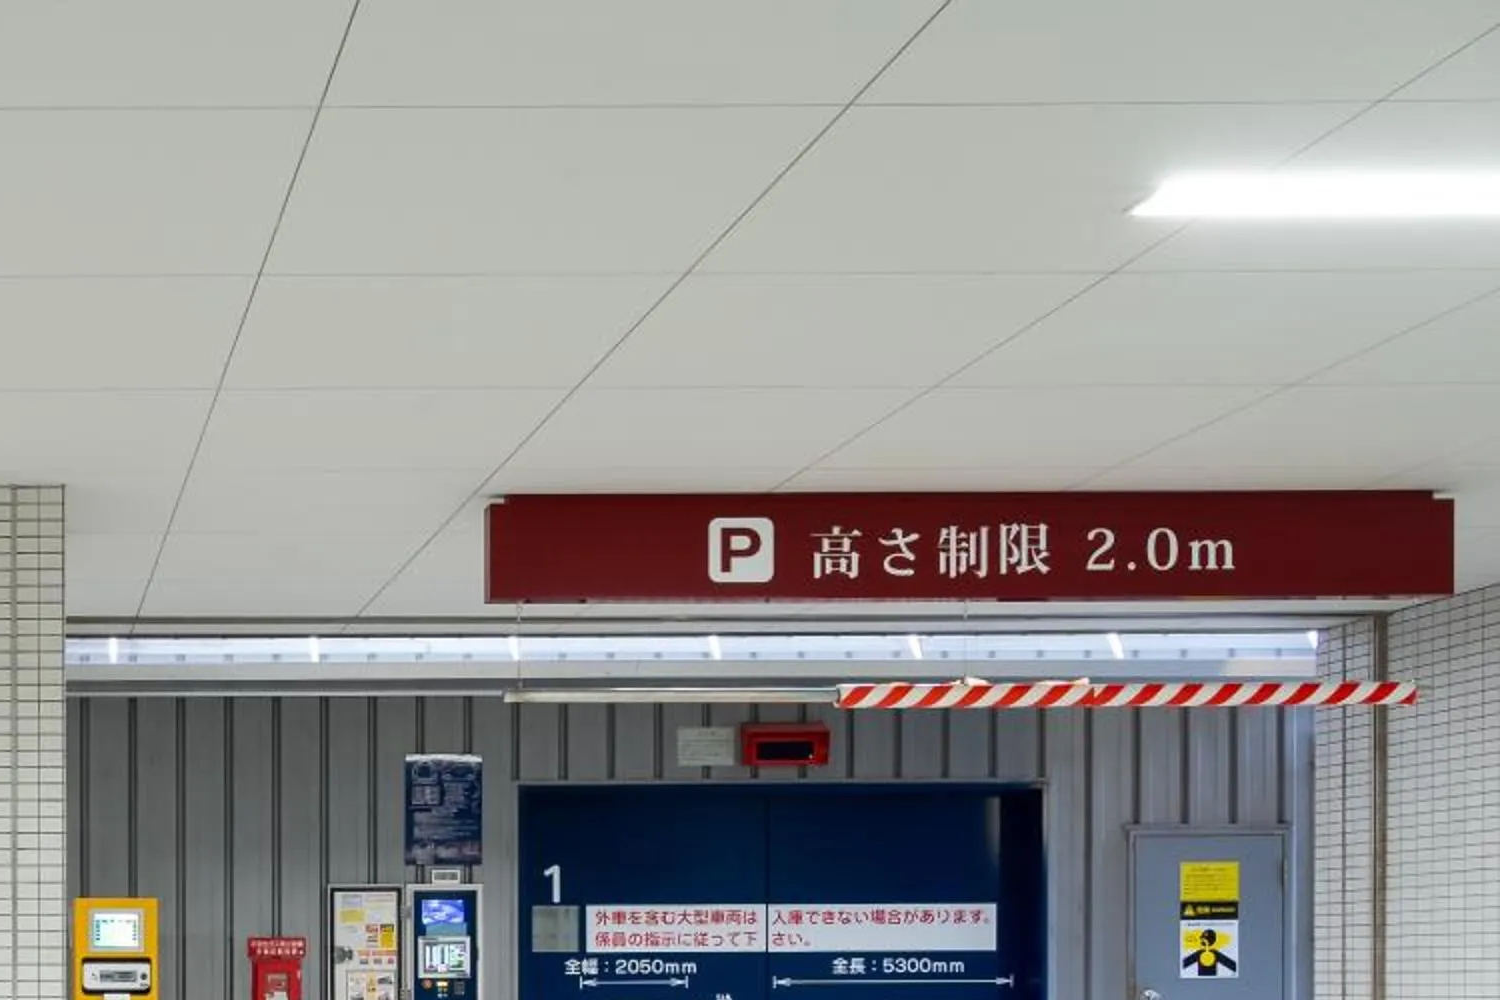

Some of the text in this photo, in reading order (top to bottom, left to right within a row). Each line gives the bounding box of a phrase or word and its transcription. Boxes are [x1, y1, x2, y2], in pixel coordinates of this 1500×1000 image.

[721, 521, 1236, 580] P 高さ制限 2.0m
[543, 864, 562, 904] 1
